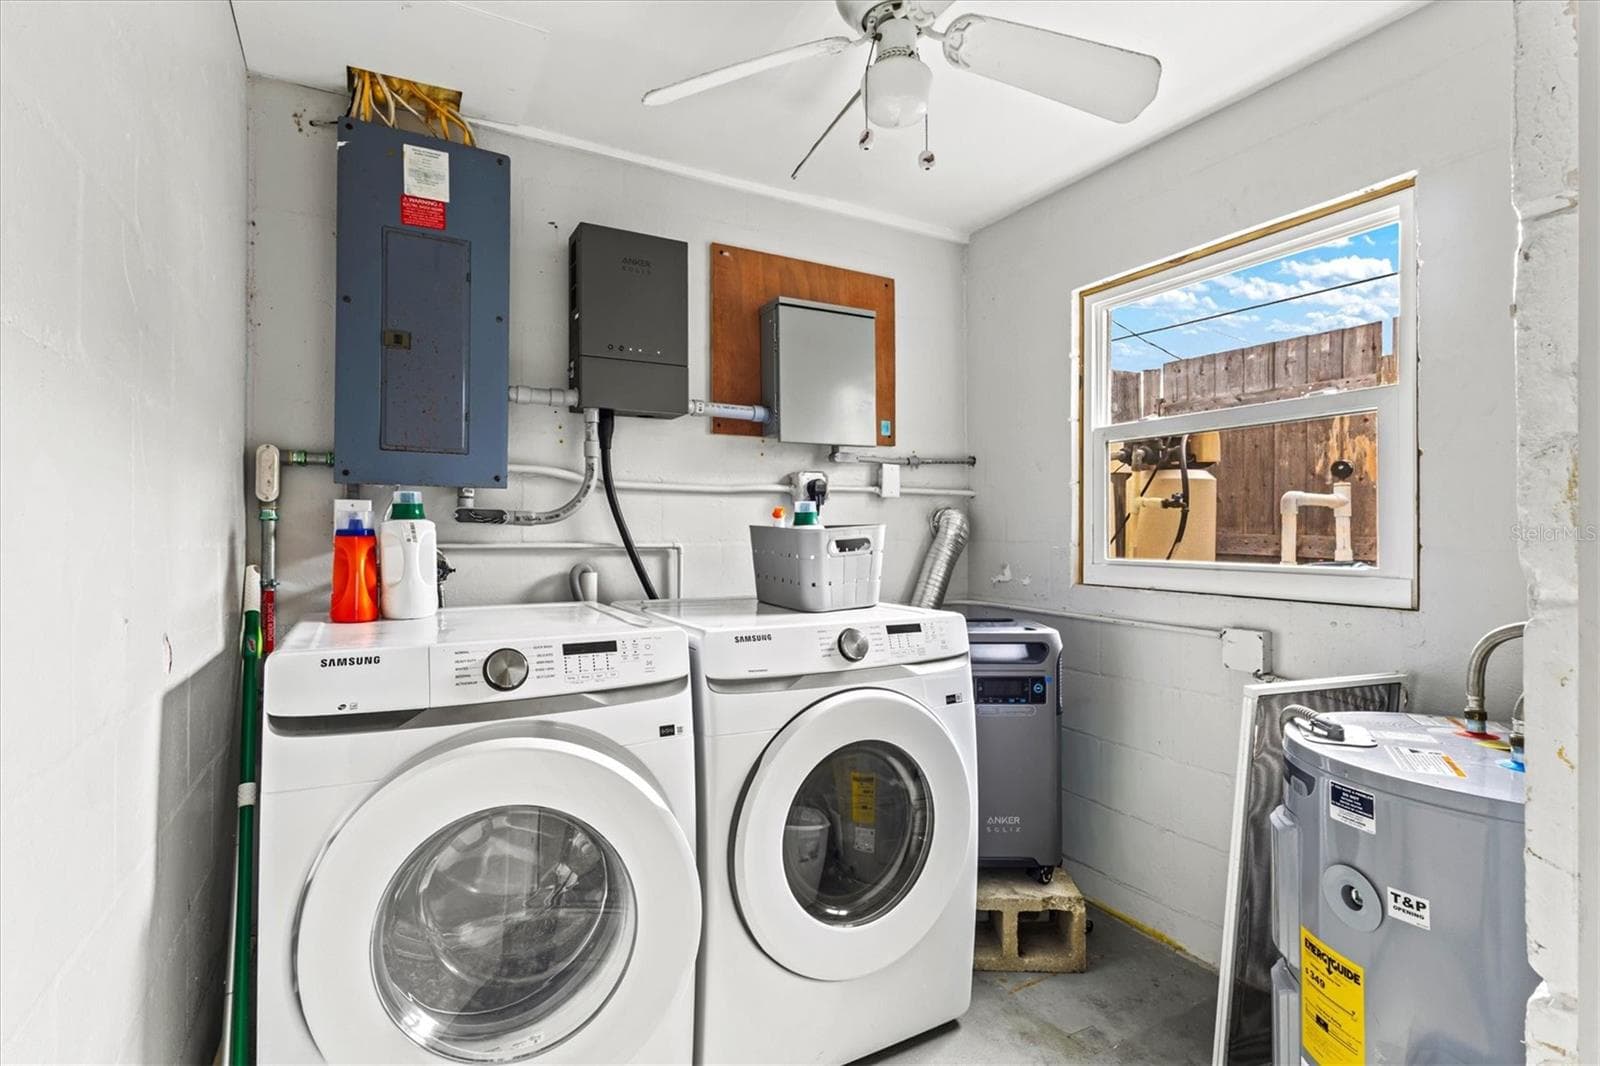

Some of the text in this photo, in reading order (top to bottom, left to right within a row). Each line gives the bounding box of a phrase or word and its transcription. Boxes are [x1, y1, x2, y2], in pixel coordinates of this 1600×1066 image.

[734, 633, 772, 644] SAMSUNG
[320, 655, 381, 668] SAMSUNG
[986, 816, 1021, 824] ANKER
[1389, 890, 1427, 912] T&P
[1392, 905, 1425, 920] OPENING
